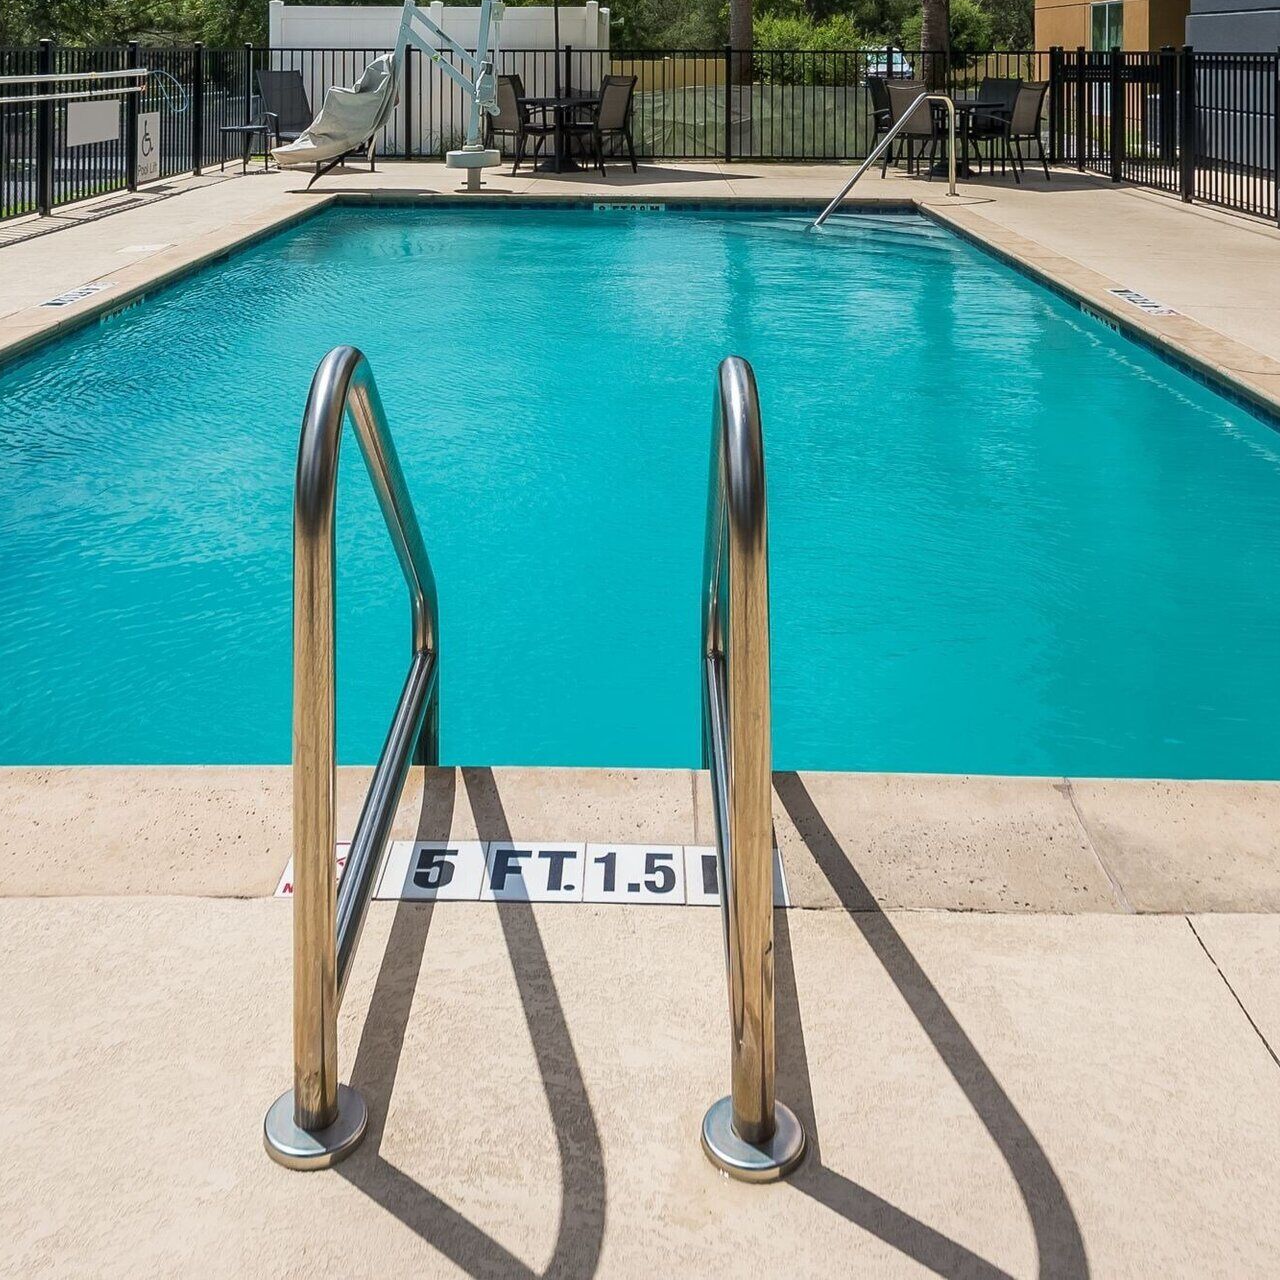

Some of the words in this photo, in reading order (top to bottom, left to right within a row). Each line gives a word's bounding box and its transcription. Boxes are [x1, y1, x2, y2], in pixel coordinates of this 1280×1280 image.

[412, 849, 459, 890] 5
[488, 850, 577, 892] FT.
[593, 852, 676, 893] 1.5
